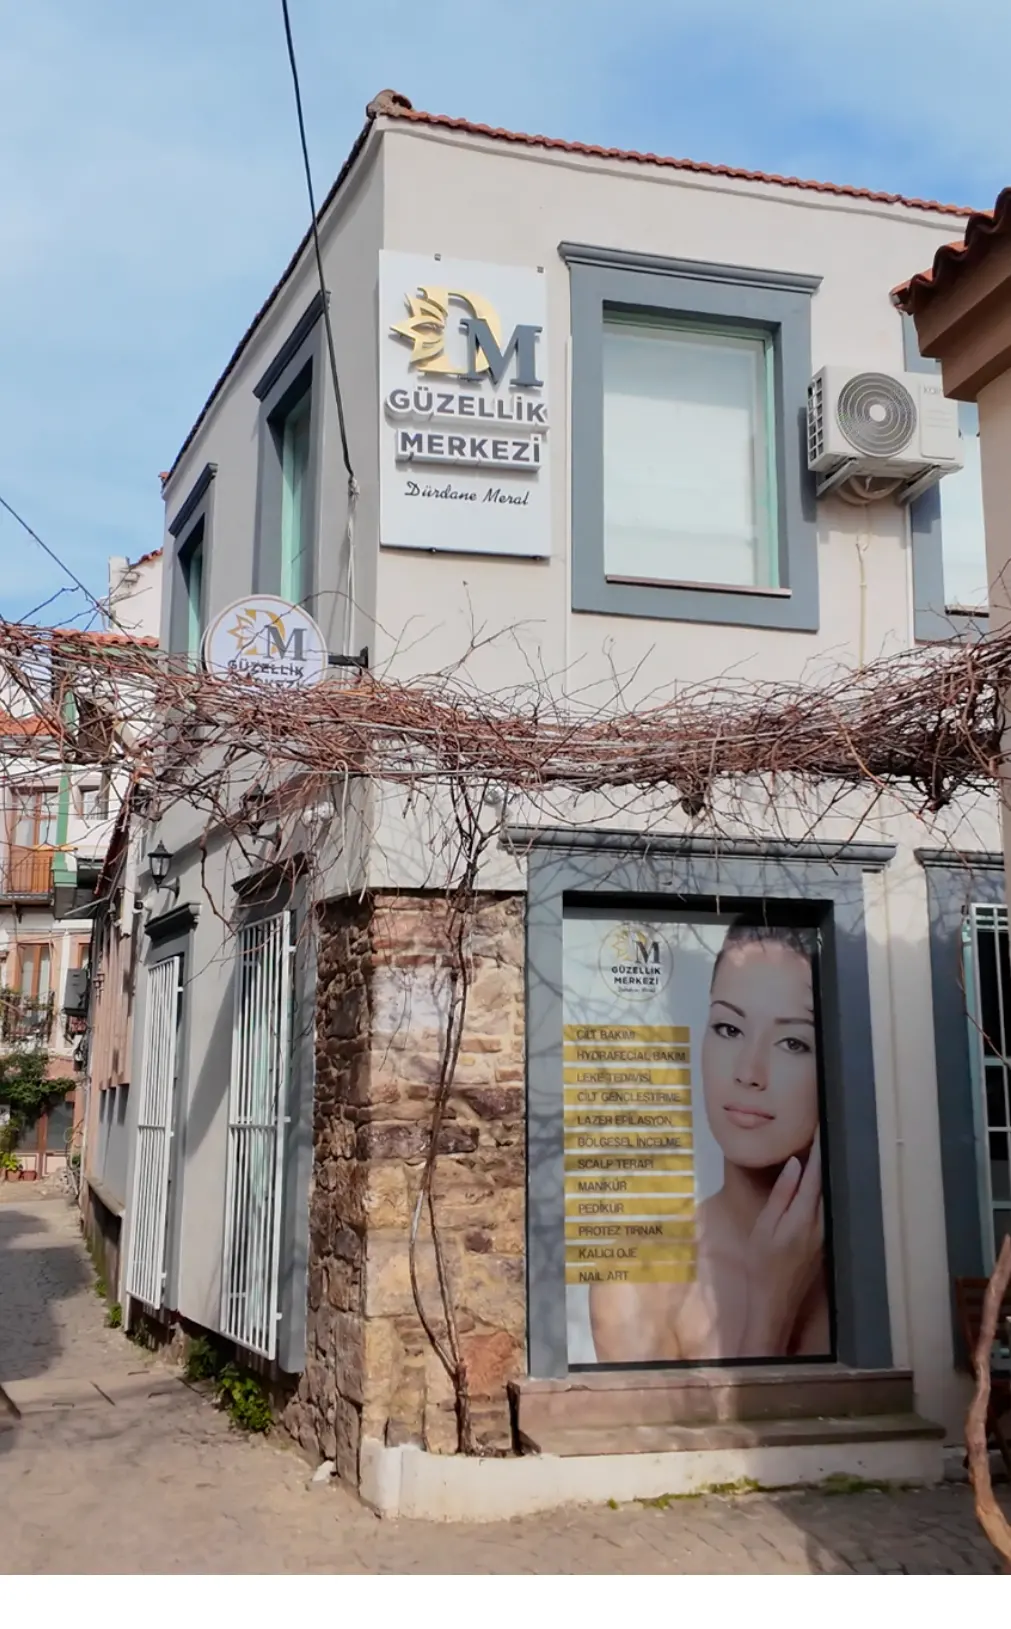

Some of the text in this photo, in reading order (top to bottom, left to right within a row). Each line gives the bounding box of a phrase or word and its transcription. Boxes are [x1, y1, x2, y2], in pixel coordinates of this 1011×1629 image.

[389, 386, 546, 424] GÜZELLİK
[400, 431, 540, 463] MERKEZİ
[404, 480, 529, 506] Dürdane Meral
[611, 964, 661, 975] GÜZELLİK
[613, 976, 659, 986] MERKEZİ
[577, 1115, 613, 1126] LAZER
[577, 1158, 614, 1170] SCALP
[578, 1224, 664, 1237] PROTEZ TIRNAK
[578, 1247, 638, 1260] KALICI OJE
[606, 1271, 630, 1282] ART
